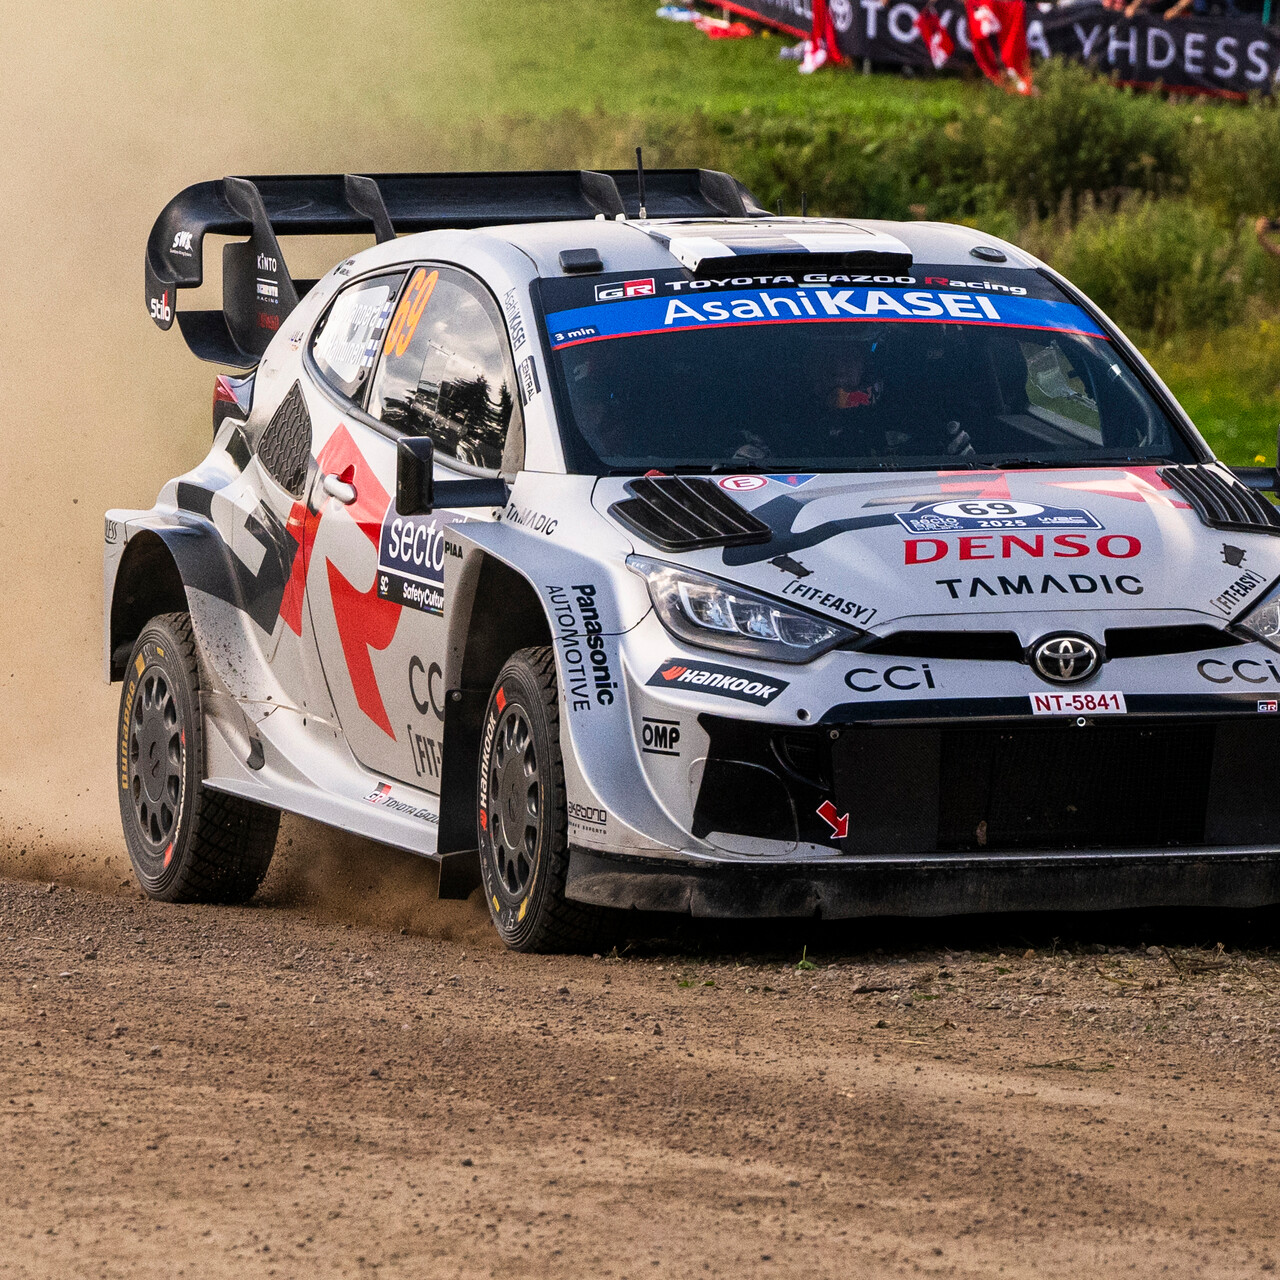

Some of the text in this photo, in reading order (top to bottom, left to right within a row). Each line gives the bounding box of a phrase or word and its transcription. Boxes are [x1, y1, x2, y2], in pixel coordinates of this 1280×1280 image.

[597, 282, 654, 300] GR
[664, 275, 795, 290] TOYOTA
[803, 273, 917, 285] GAZOO
[150, 290, 171, 322] Stilo
[384, 268, 439, 357] 69
[664, 289, 1001, 325] AsahiKASEI
[554, 326, 596, 342] 3 min
[521, 358, 536, 402] CENTRAL
[958, 502, 1018, 516] 69
[977, 519, 1027, 528] 2025
[444, 541, 463, 559] PIAA
[903, 534, 1142, 565] DENSO
[935, 574, 1144, 599] TAMADIC
[545, 585, 591, 712] AUTOMOTIVE
[571, 584, 618, 706] Panasonic
[1034, 693, 1121, 712] NT-5841
[642, 726, 680, 749] OMP
